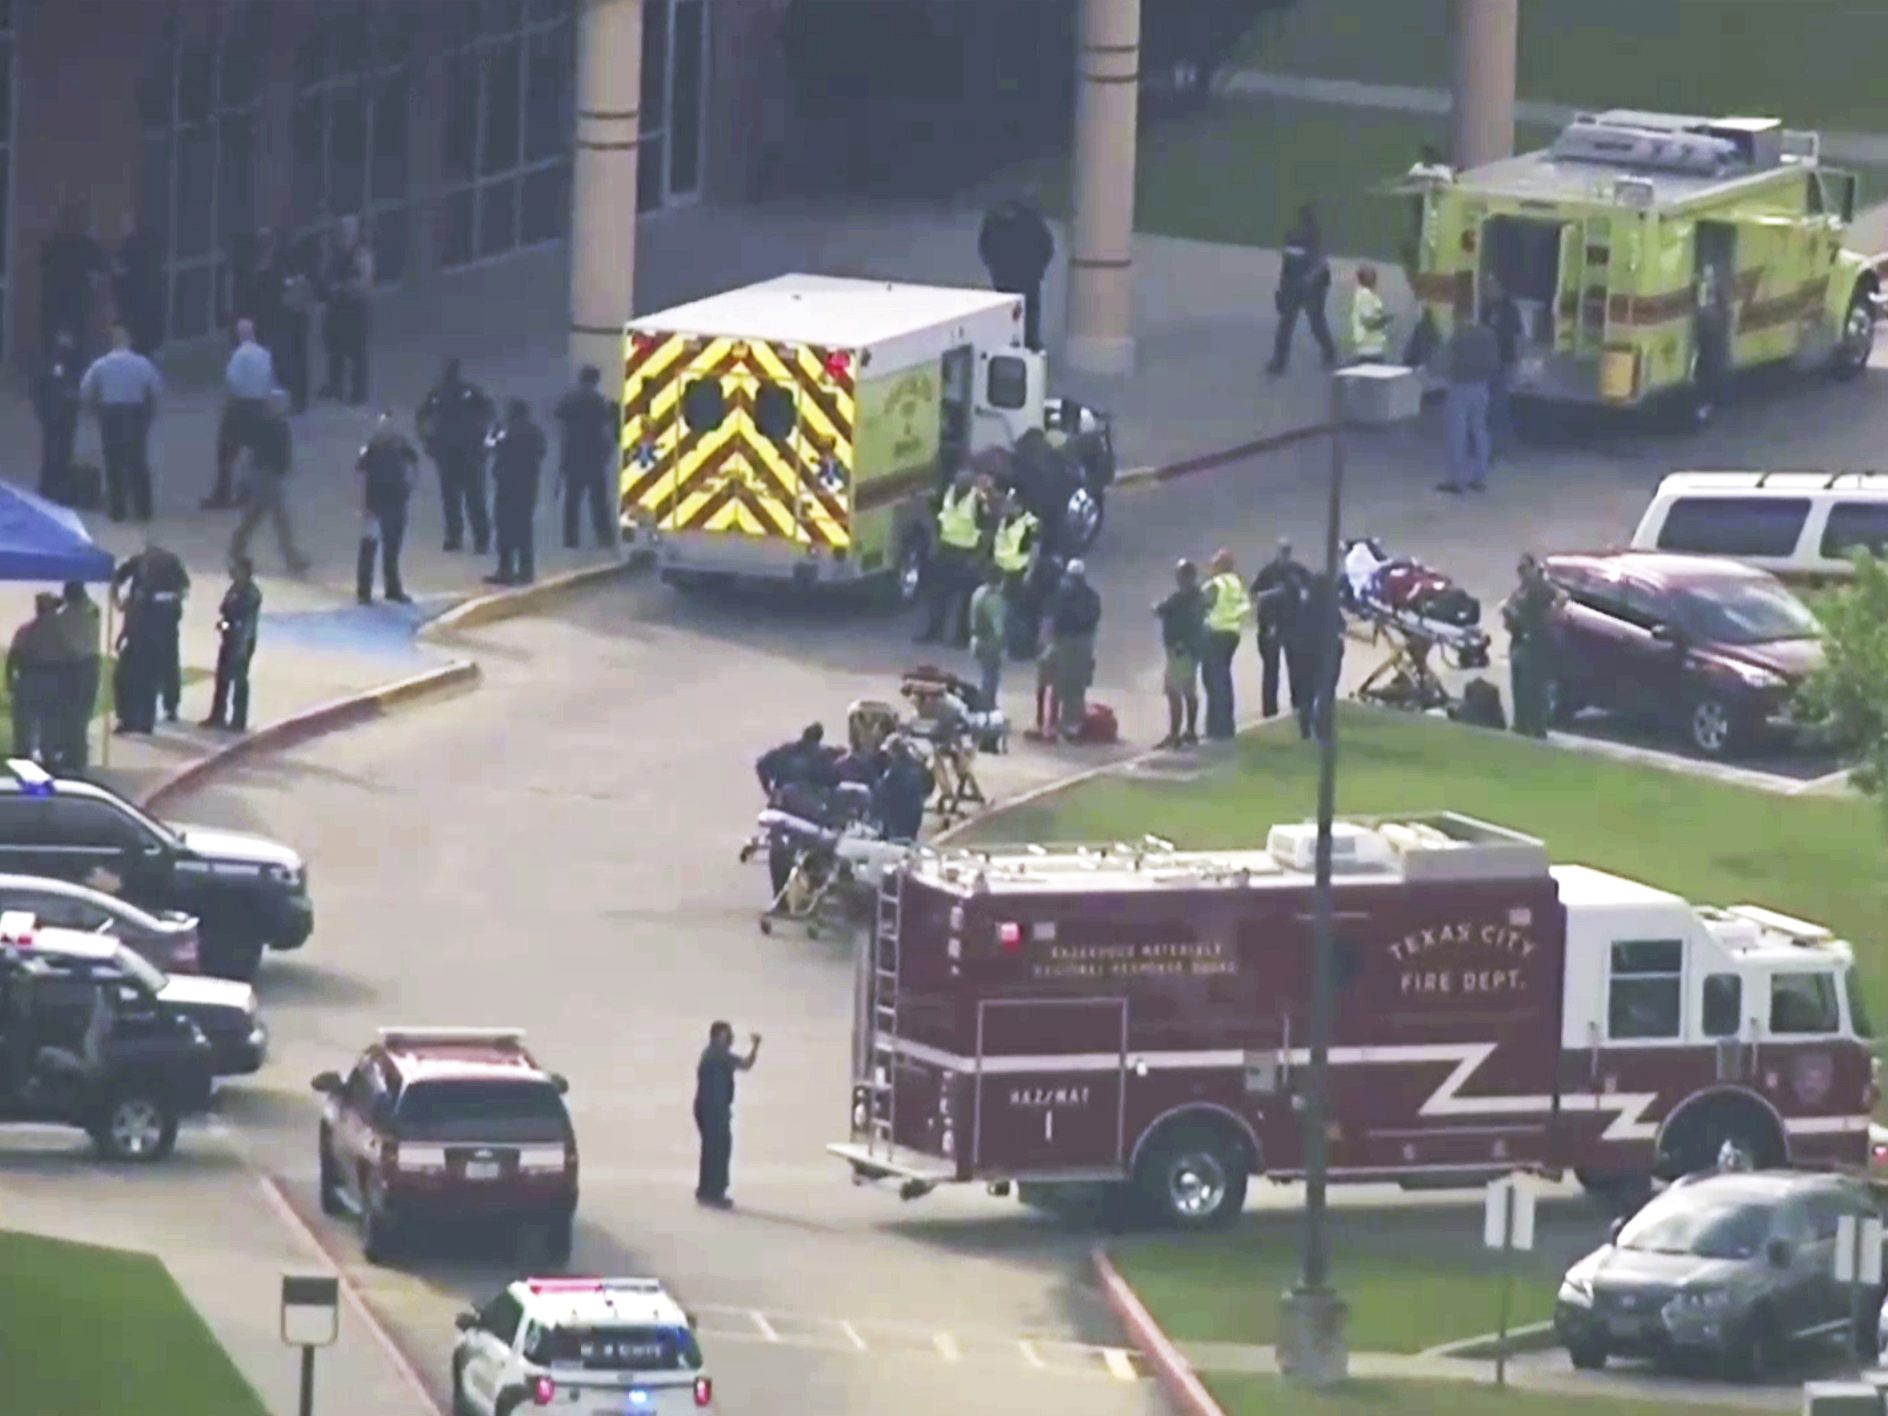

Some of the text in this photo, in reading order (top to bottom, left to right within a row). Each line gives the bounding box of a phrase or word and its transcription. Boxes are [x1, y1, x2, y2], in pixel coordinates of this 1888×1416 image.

[1388, 923, 1537, 961] TEXAS CITY
[1401, 969, 1528, 994] FIRE DEPT.
[1010, 1086, 1090, 1105] HAZ/MAT
